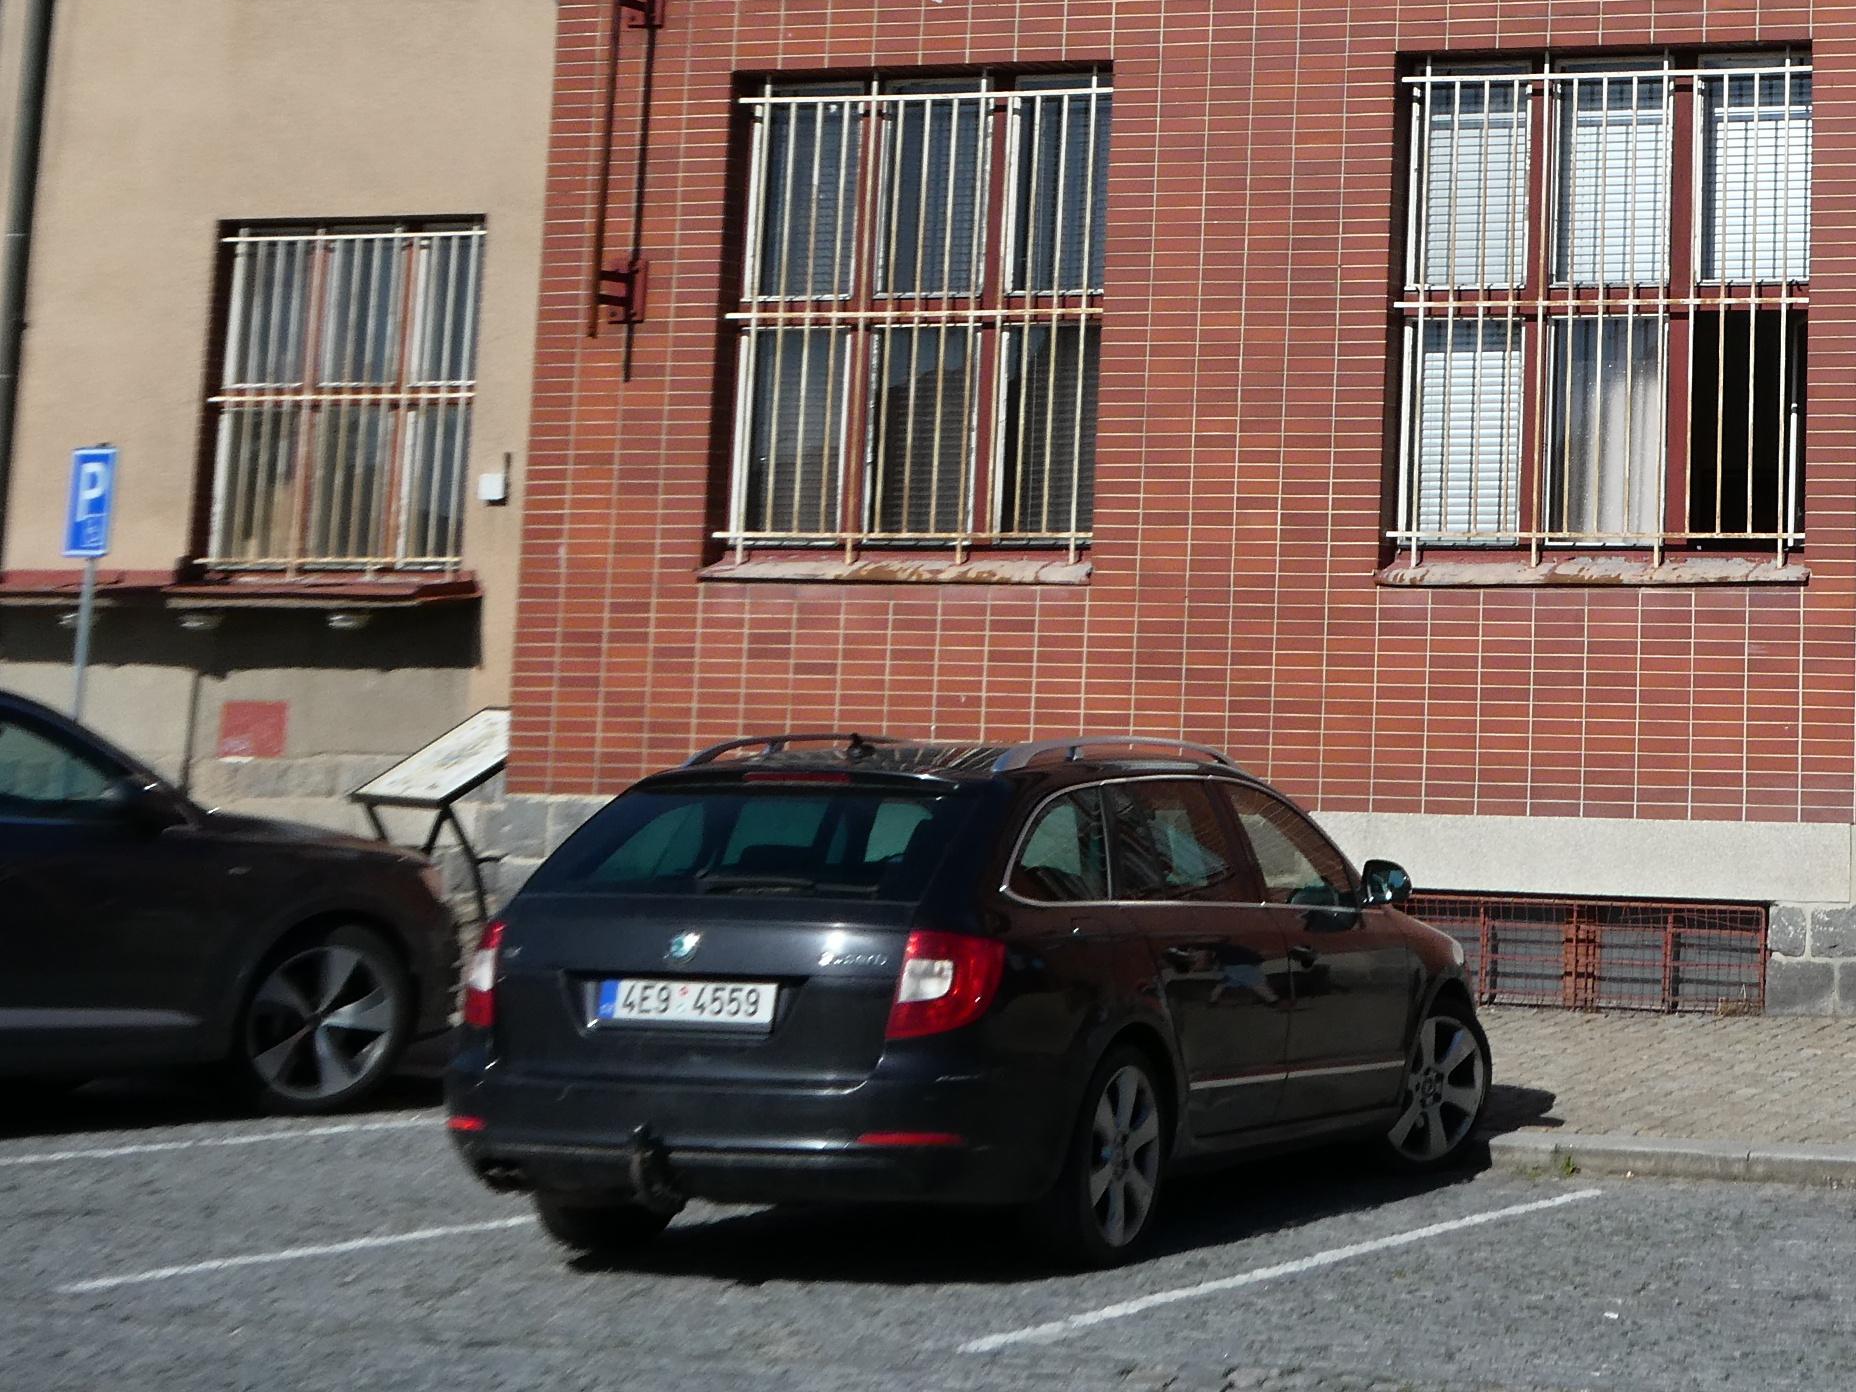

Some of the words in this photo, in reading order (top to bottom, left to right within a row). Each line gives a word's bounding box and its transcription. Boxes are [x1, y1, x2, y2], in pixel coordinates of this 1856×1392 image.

[75, 461, 112, 522] P
[622, 980, 671, 1015] 4E9
[692, 984, 761, 1017] 4559
